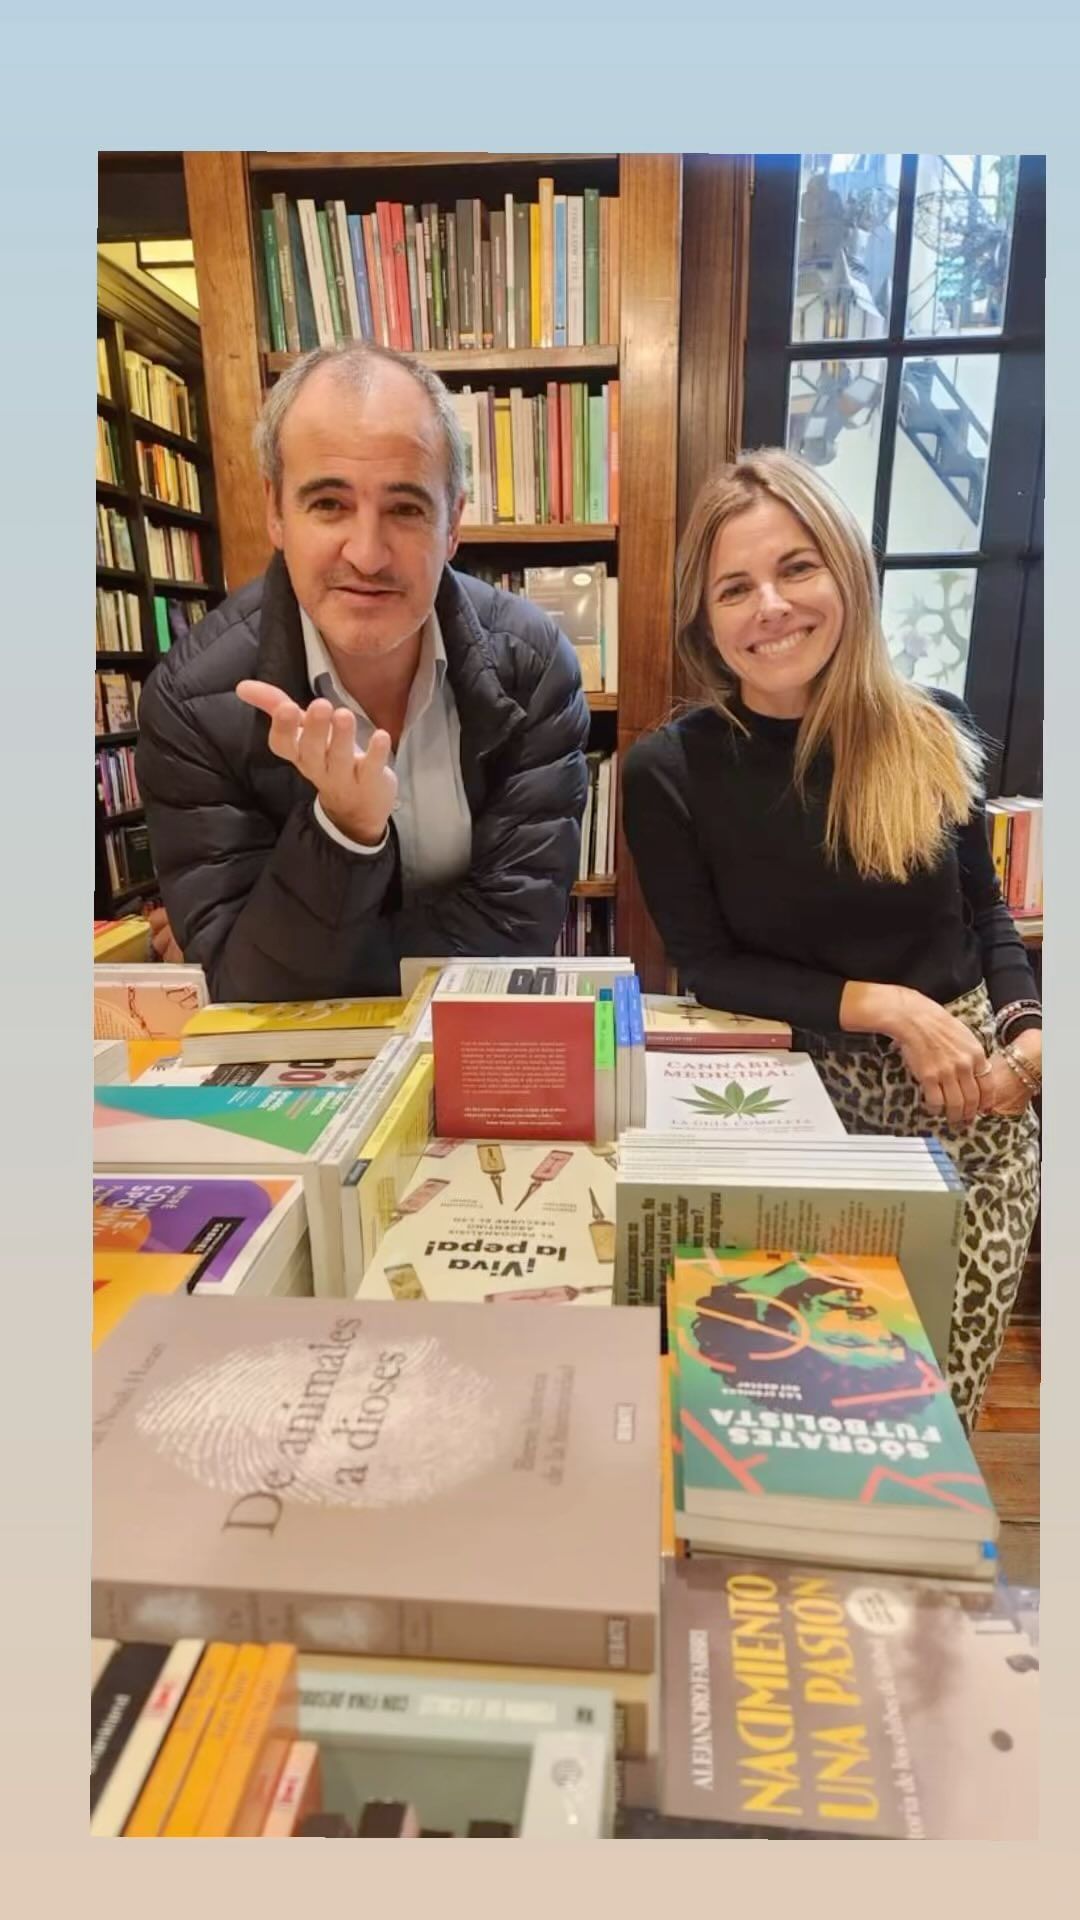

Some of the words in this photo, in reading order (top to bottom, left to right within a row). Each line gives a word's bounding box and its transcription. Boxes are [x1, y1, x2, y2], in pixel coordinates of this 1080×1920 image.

[663, 1068, 796, 1080] MEDICINAL
[666, 1060, 788, 1070] CANNABIS
[733, 1118, 813, 1126] COMPLETA
[424, 1240, 528, 1256] pepa!
[536, 1245, 567, 1262] la
[448, 1256, 537, 1277] ¡Viva
[332, 1352, 407, 1451] dioses
[222, 1469, 296, 1538] De
[277, 1318, 362, 1456] animales
[709, 1407, 943, 1445] FUTBOLISTA
[728, 1427, 930, 1460] SÓCRATES
[332, 1464, 370, 1487] a
[787, 1574, 862, 1707] PASIÓN
[726, 1574, 804, 1816] NACIMIENTO
[690, 1682, 714, 1792] ALEJANDRO
[888, 1747, 911, 1770] los
[808, 1721, 880, 1822] UNA
[891, 1772, 915, 1793] de
